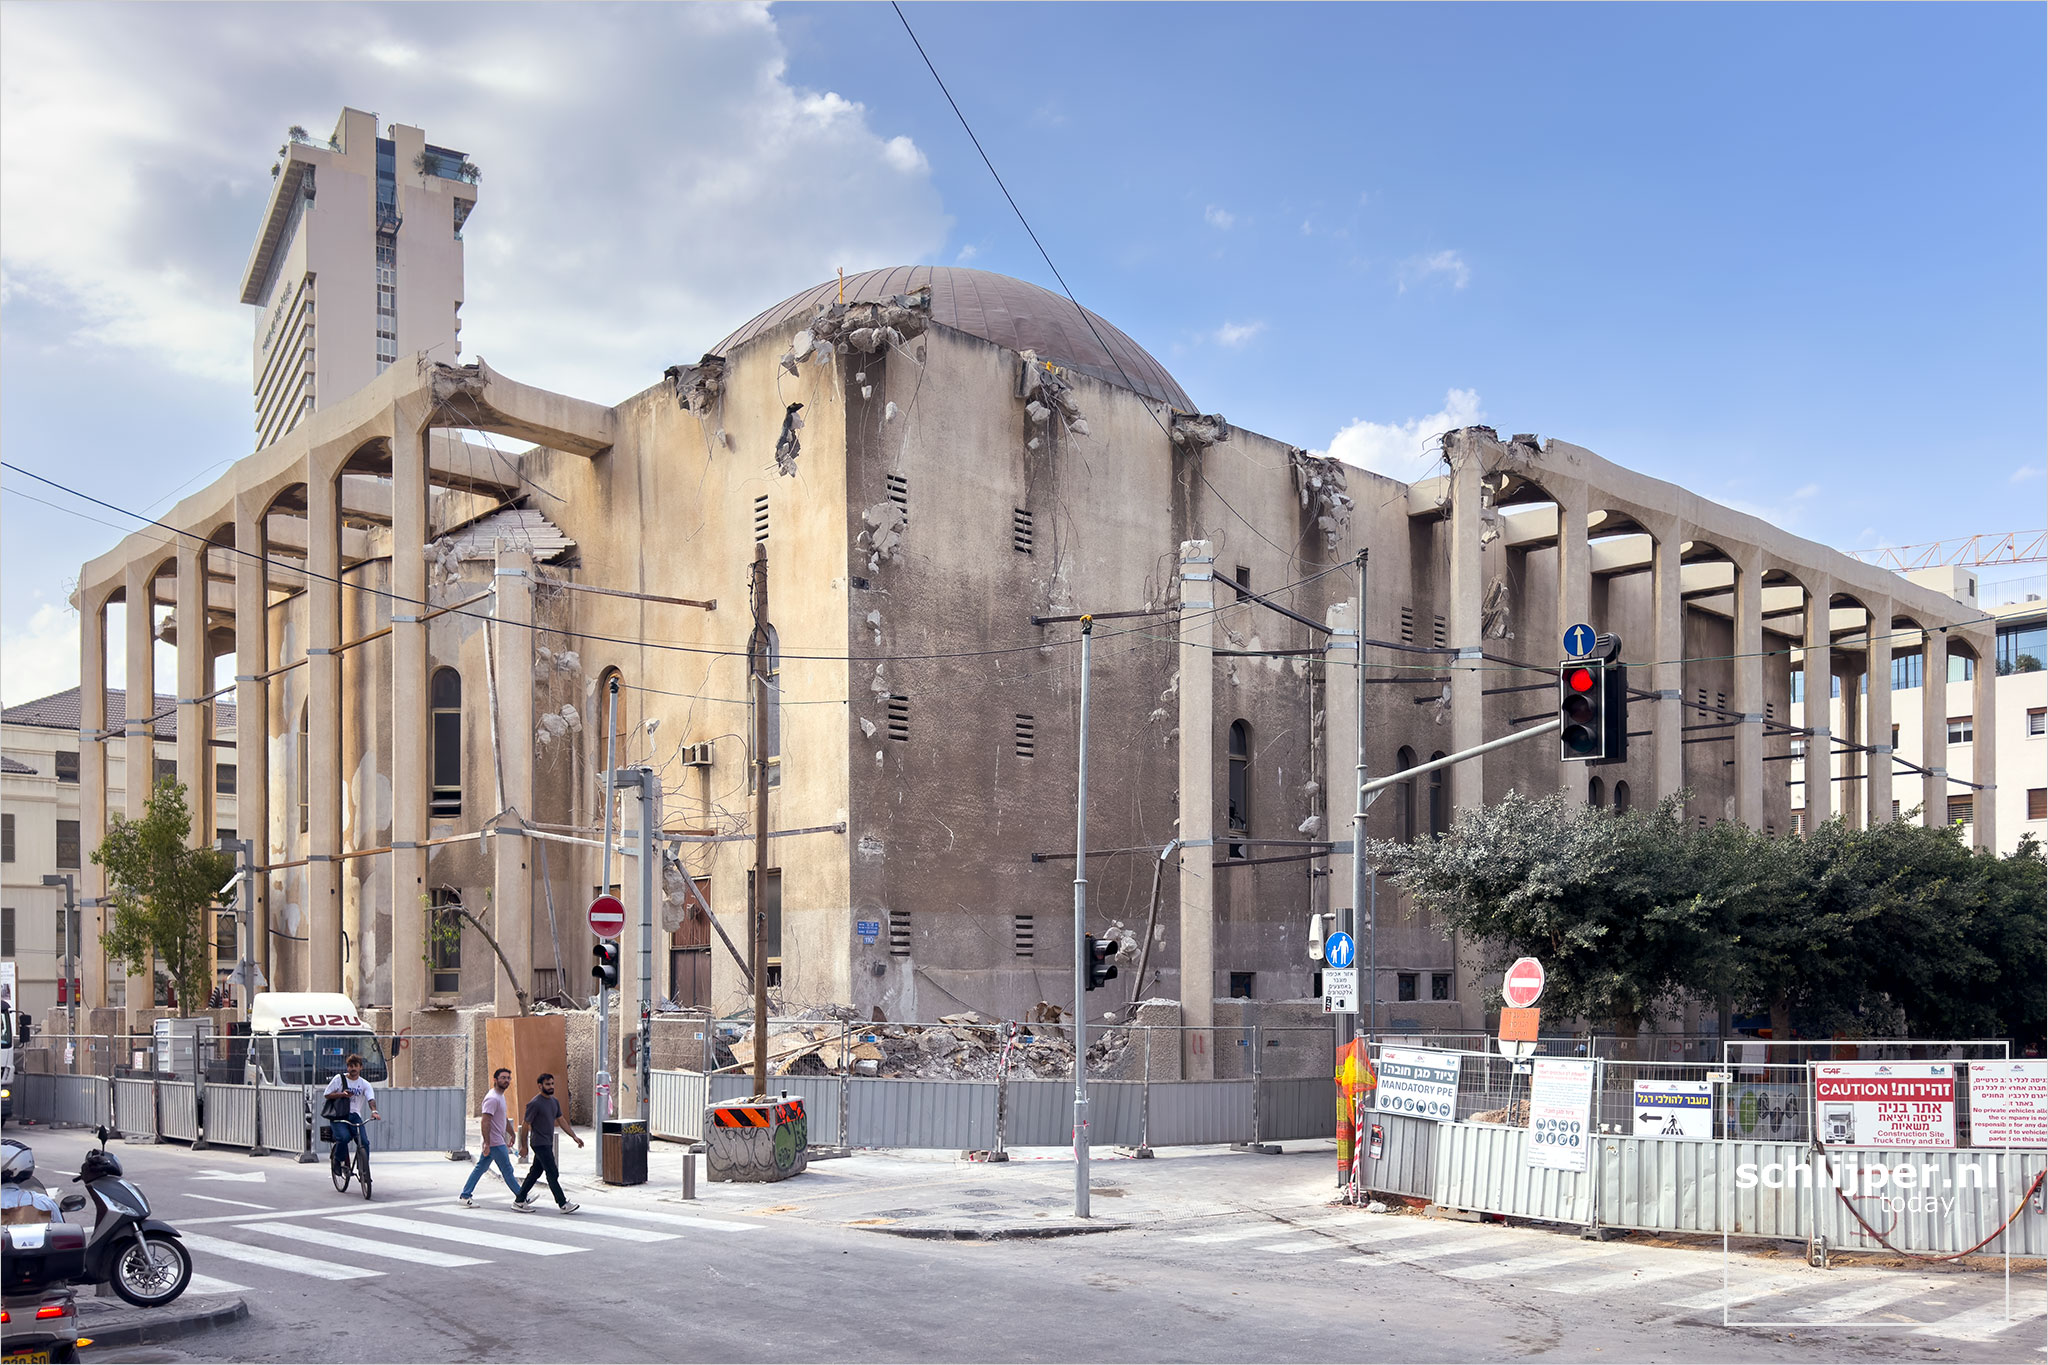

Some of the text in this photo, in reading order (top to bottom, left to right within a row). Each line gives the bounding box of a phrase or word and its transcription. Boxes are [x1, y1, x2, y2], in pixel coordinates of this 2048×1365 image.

[280, 1014, 361, 1028] ISUZU
[1383, 1063, 1455, 1082] ציוד מגן חובה!
[1822, 1067, 1841, 1075] CAF
[1381, 1079, 1454, 1098] MANDATORY PPE
[1819, 1083, 1888, 1096] CAUTION
[1637, 1093, 1709, 1105] מעבר להולכי רגל
[1878, 1103, 1942, 1114] אתר בניה
[1878, 1114, 1942, 1123] כניסה ויציאת
[1891, 1122, 1930, 1131] משאיות
[1877, 1130, 1945, 1138] Construction Site
[1895, 1137, 1916, 1146] Entry
